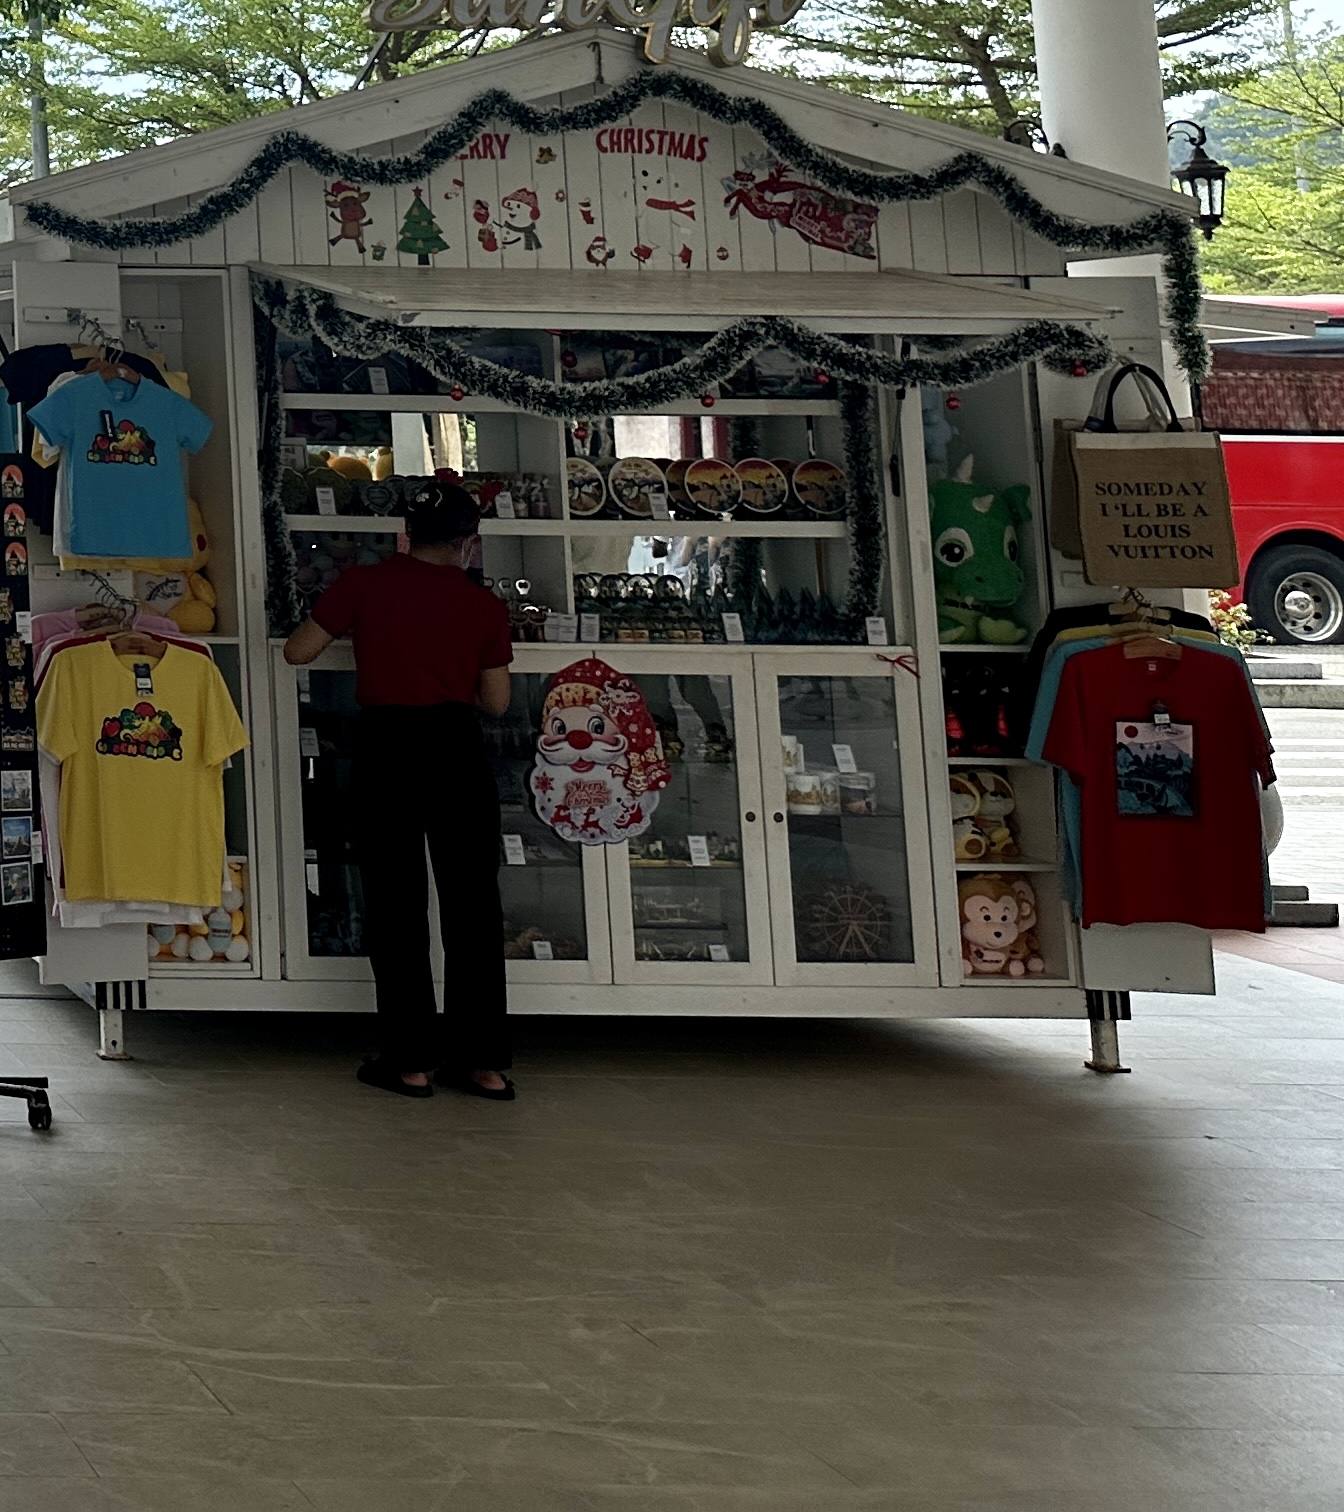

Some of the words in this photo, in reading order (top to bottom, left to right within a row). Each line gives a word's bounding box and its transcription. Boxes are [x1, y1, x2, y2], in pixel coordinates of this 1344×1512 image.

[455, 133, 510, 160] RRY
[595, 128, 710, 163] CHRISTMAS
[1095, 481, 1207, 497] SOMEDAY
[1156, 502, 1186, 517] BE
[1192, 503, 1209, 517] A
[1122, 523, 1191, 539] LOUIS
[1107, 544, 1214, 560] VUITTON
